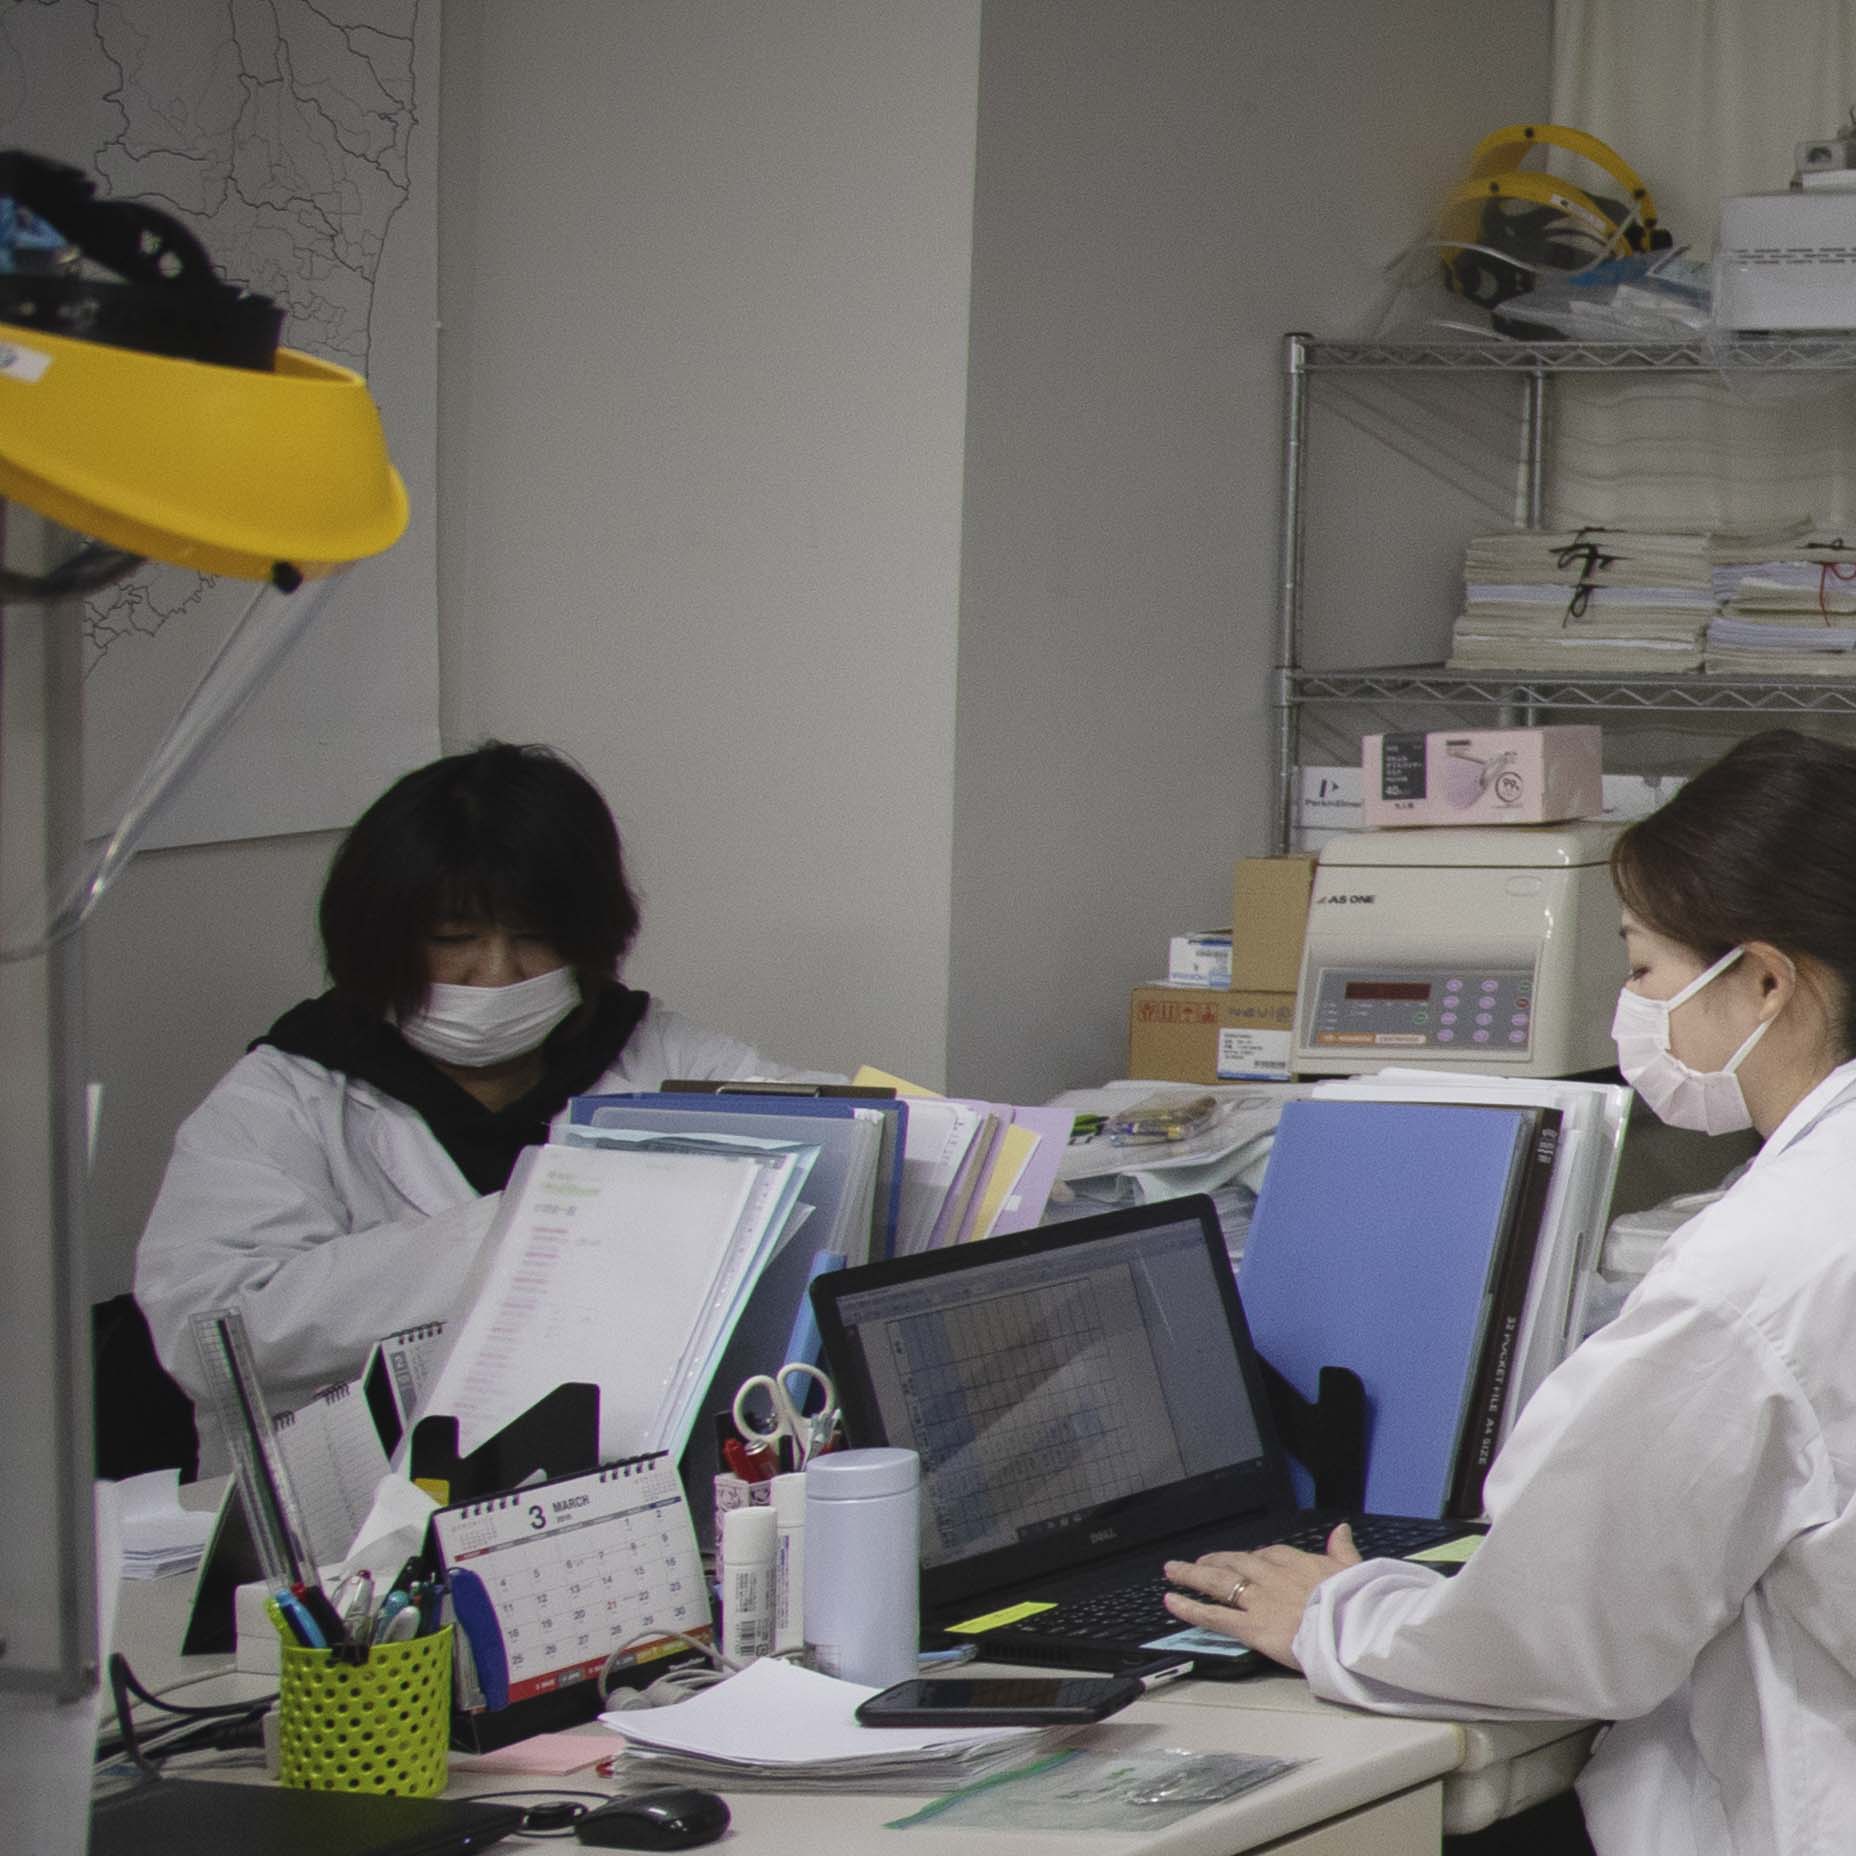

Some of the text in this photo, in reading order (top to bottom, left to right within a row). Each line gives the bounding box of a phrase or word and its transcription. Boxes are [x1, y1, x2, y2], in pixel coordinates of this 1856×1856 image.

[1328, 895, 1375, 904] AS ONE
[528, 1494, 590, 1530] 3 MARCH
